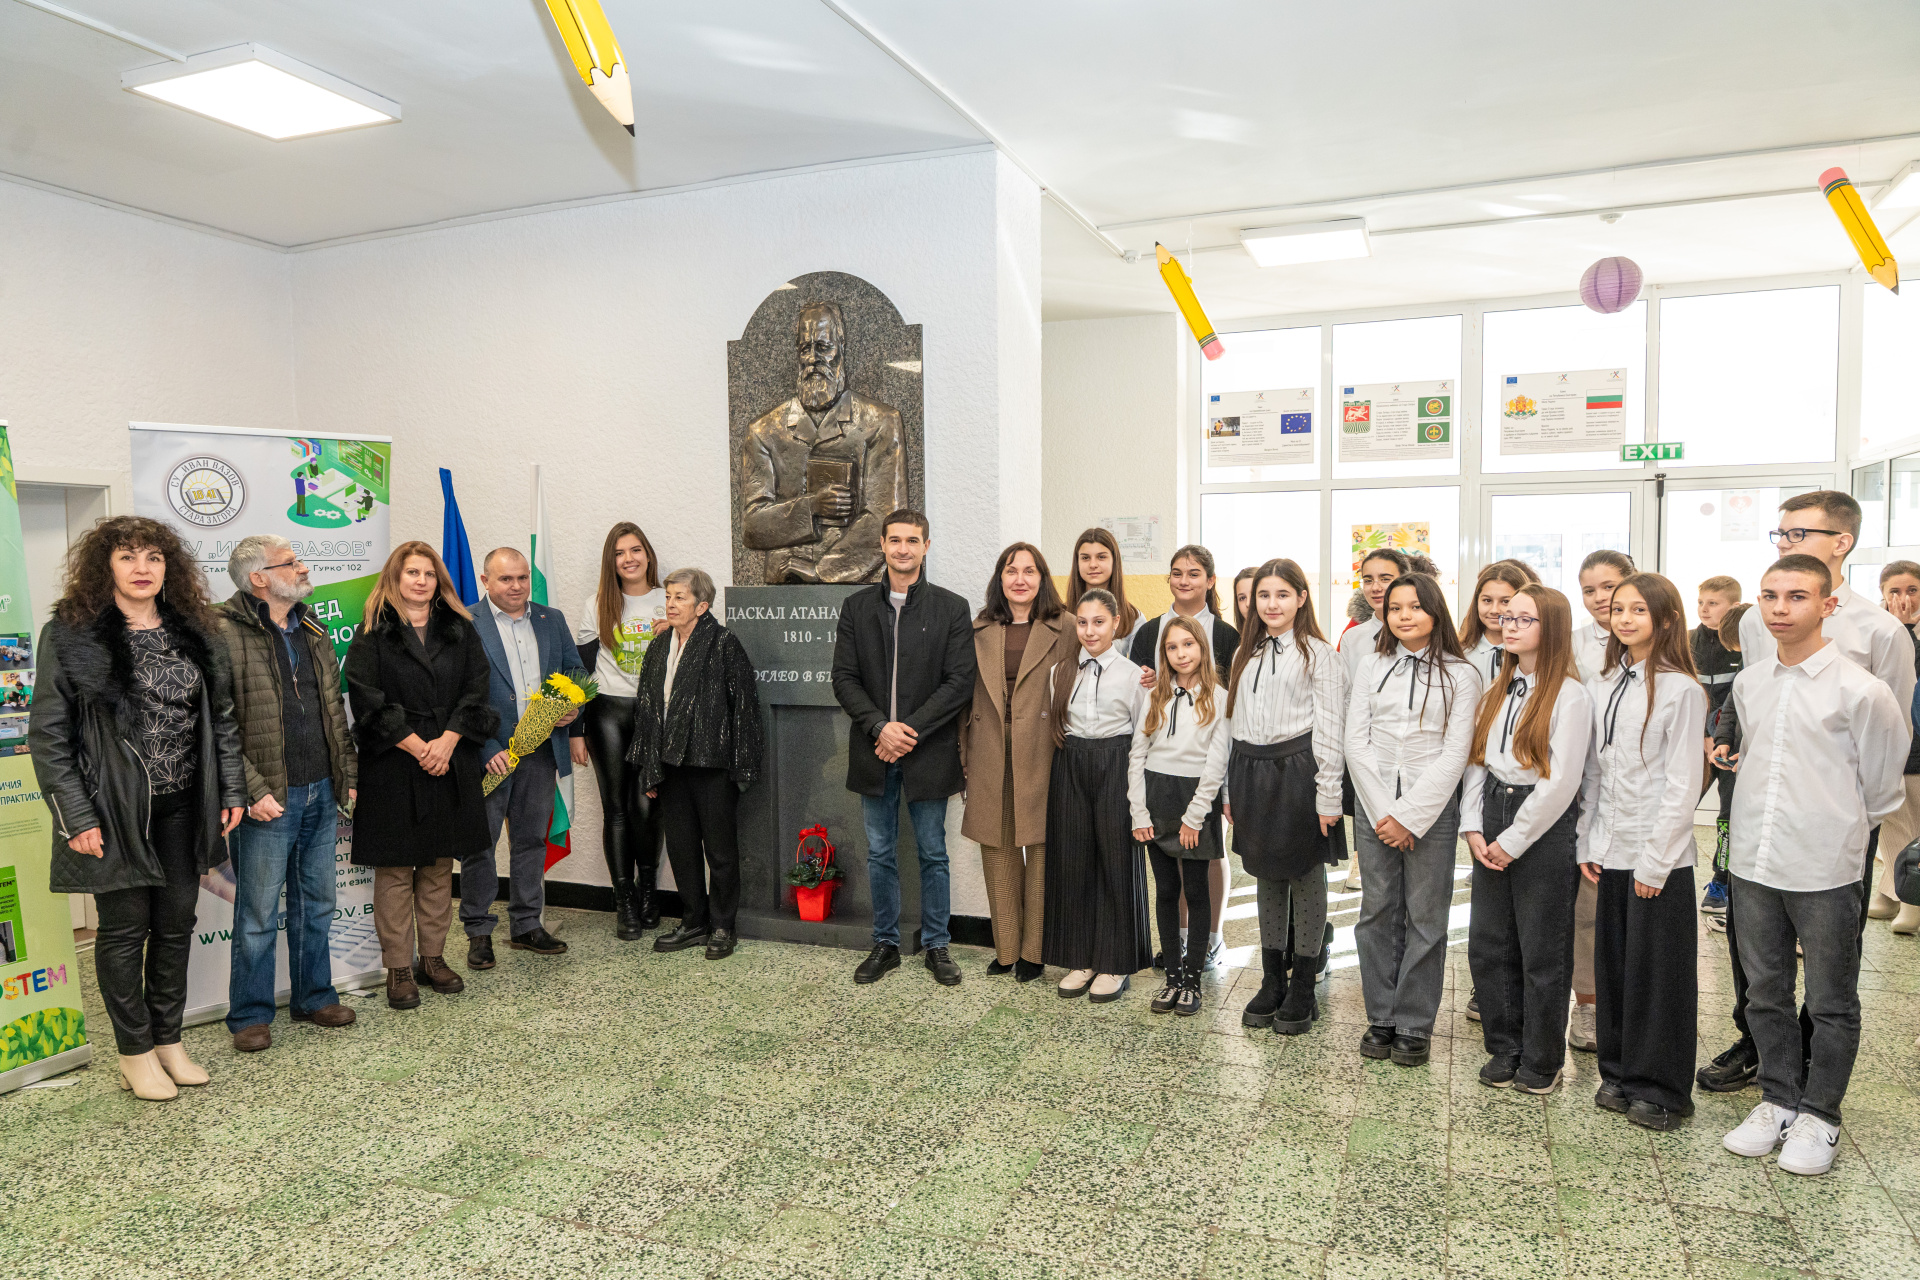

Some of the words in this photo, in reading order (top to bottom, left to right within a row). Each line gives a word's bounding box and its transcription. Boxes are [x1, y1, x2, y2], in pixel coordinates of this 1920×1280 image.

[1625, 444, 1680, 460] EXIT
[171, 475, 181, 488] СУ
[179, 505, 205, 523] СТАРА
[207, 506, 237, 524] ЗАГОРА
[727, 606, 785, 622] ДАСКАЛ
[789, 606, 841, 620] АТАНА
[625, 623, 651, 634] STEM
[784, 631, 812, 643] 1810
[802, 670, 812, 681] В
[349, 877, 373, 887] език
